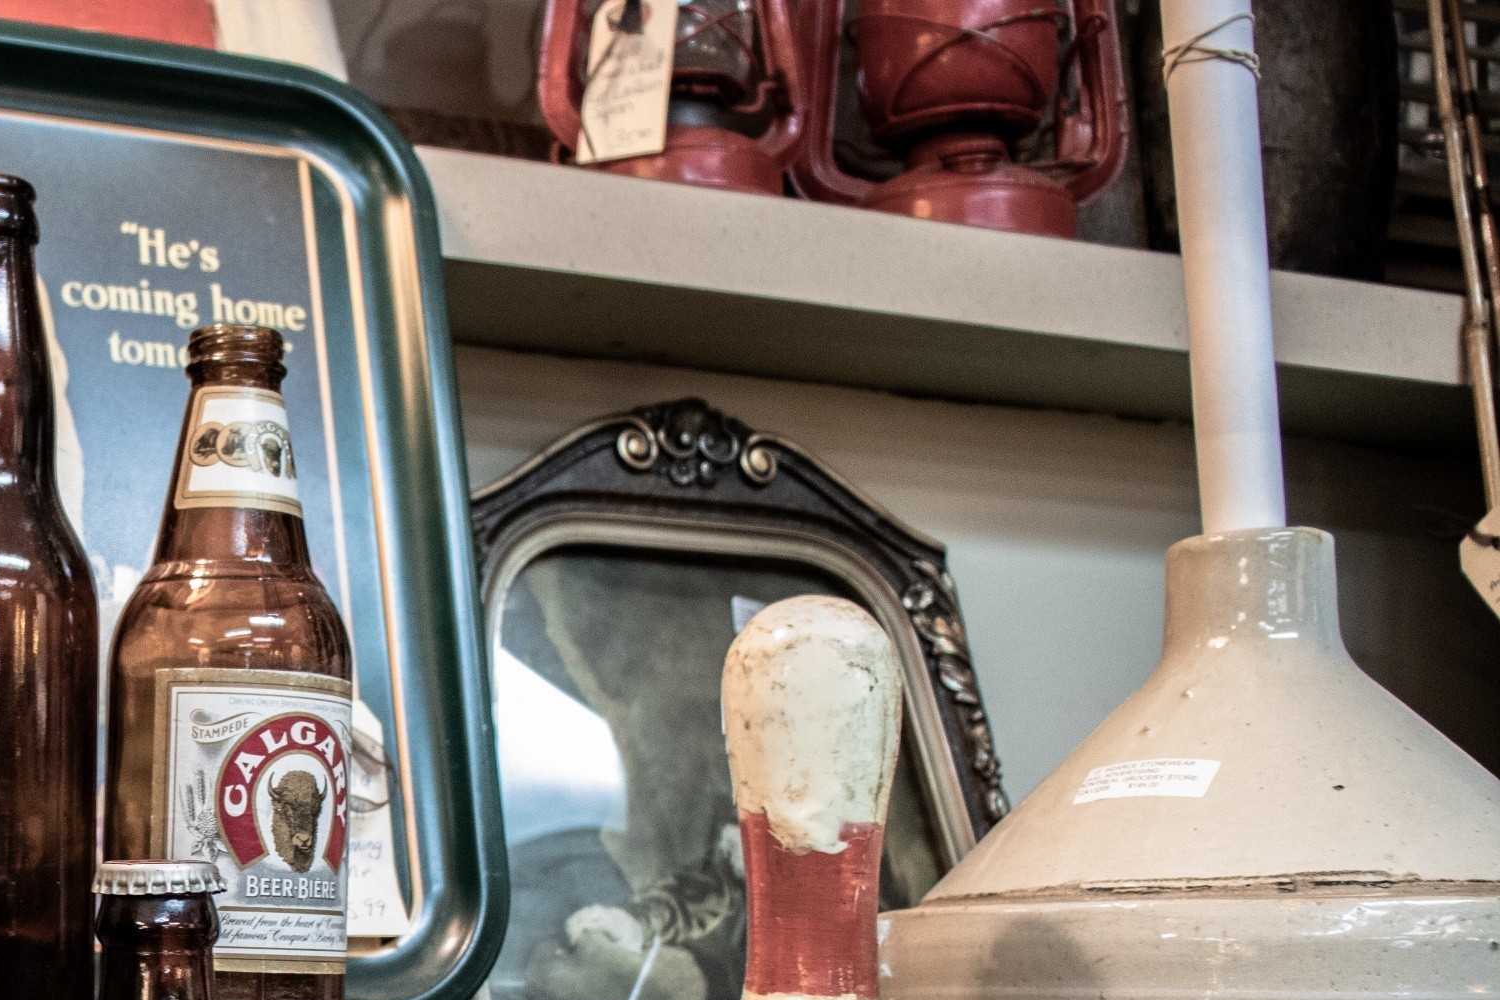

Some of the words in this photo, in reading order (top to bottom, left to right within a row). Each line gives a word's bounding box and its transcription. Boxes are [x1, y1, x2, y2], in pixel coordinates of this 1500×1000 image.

[61, 279, 200, 330] coming
[210, 282, 307, 332] home
[191, 717, 251, 741] STAMPEDE
[223, 720, 348, 829] CALGARY
[1139, 760, 1197, 768] STONEWEAR
[1166, 774, 1198, 782] STORE
